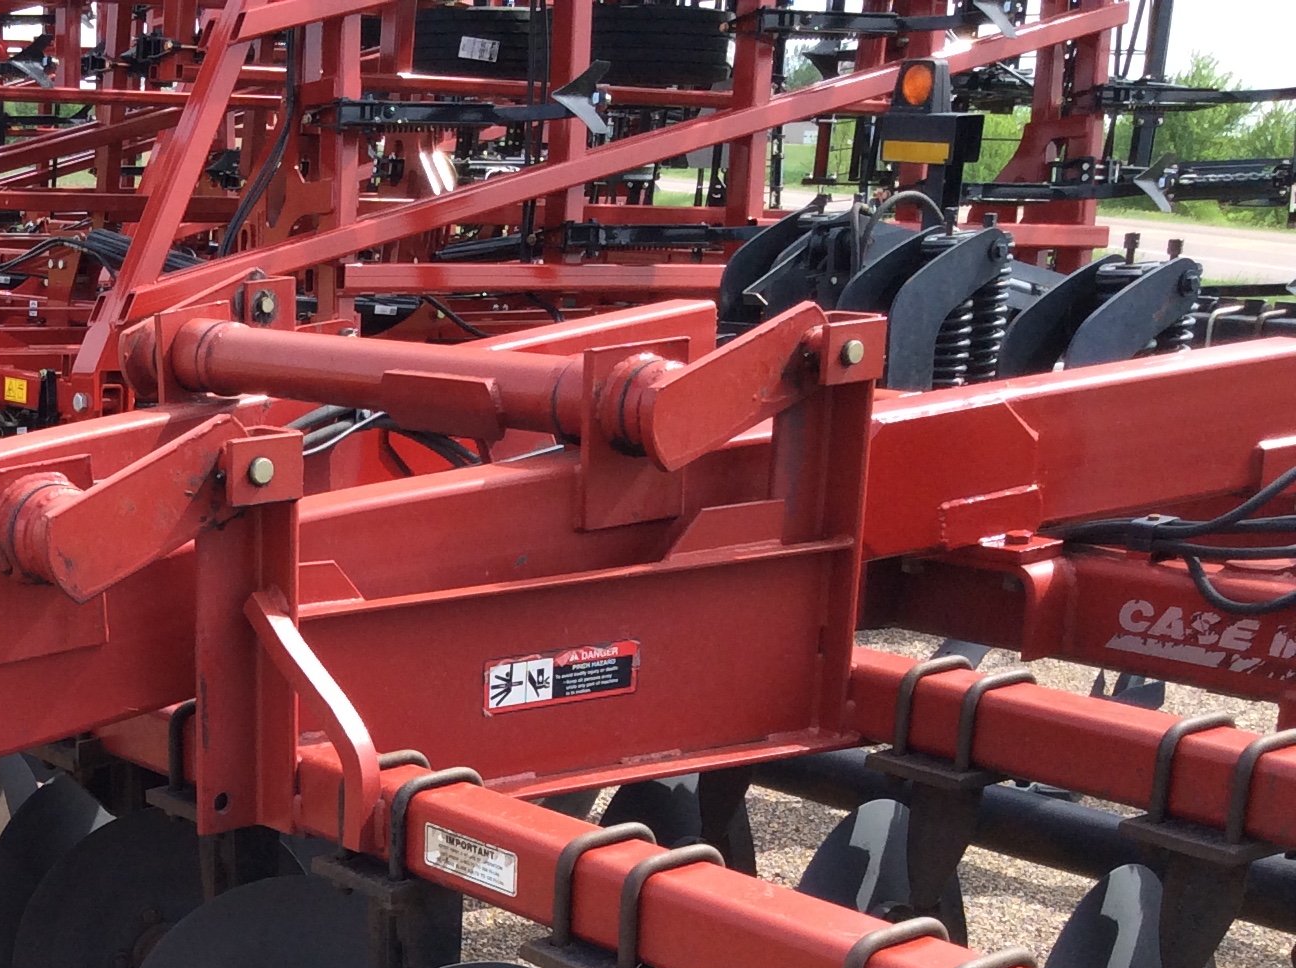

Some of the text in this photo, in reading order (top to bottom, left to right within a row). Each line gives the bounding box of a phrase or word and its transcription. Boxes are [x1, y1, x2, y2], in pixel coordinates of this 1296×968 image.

[1118, 599, 1262, 652] CASE
[581, 646, 619, 660] DANGER
[445, 835, 495, 860] IMPORTANT
